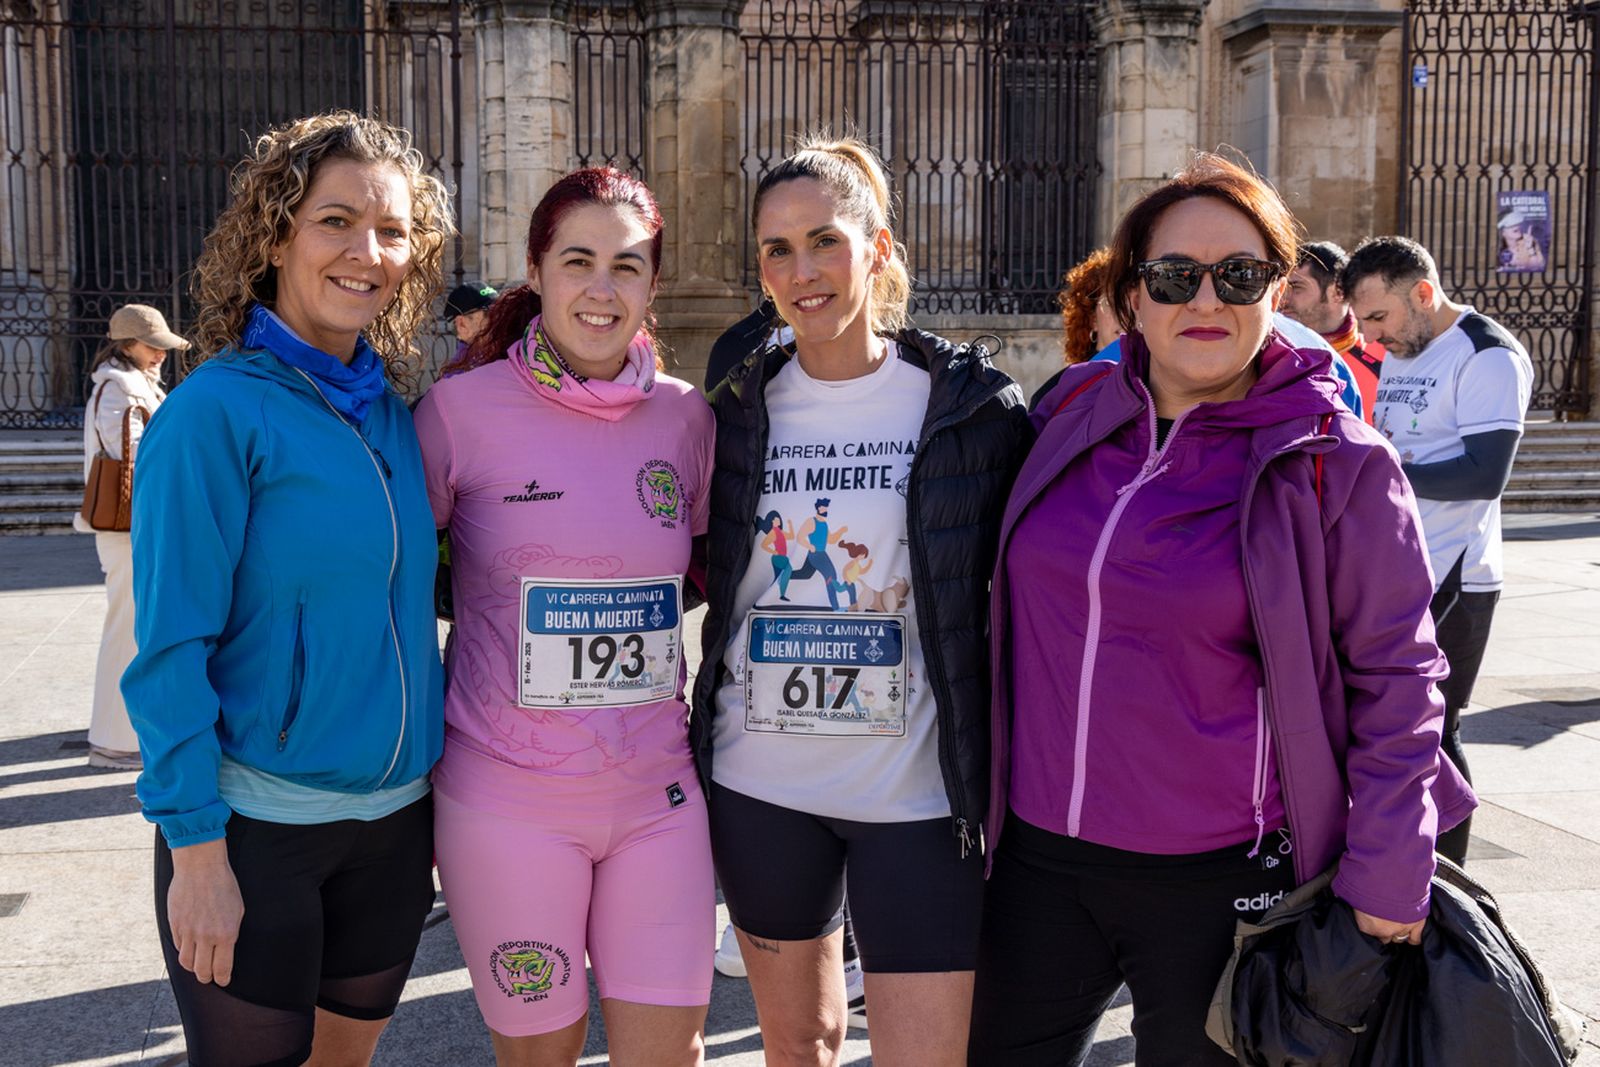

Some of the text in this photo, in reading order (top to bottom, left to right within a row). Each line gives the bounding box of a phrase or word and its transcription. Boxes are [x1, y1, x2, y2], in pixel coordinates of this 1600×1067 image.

[1500, 196, 1546, 206] LA CATEDRAL
[843, 440, 919, 458] CAMINA
[761, 465, 893, 495] ENA MUERTE
[503, 491, 564, 503] TEAMERGY
[546, 589, 665, 605] VI CARRERA CAMINATA
[544, 609, 645, 629] BUENA MUERTE
[765, 623, 885, 637] VI CARRERA CAMINATA
[568, 634, 646, 680] 193
[763, 640, 857, 659] BUENA MUERTE
[569, 681, 589, 690] ESTER
[782, 666, 861, 710] 617
[776, 709, 795, 718] ISABEL
[796, 710, 828, 719] QUESADA
[1234, 890, 1289, 911] adid
[489, 940, 571, 998] ASOCIACION DEPORTIVA MARATON
